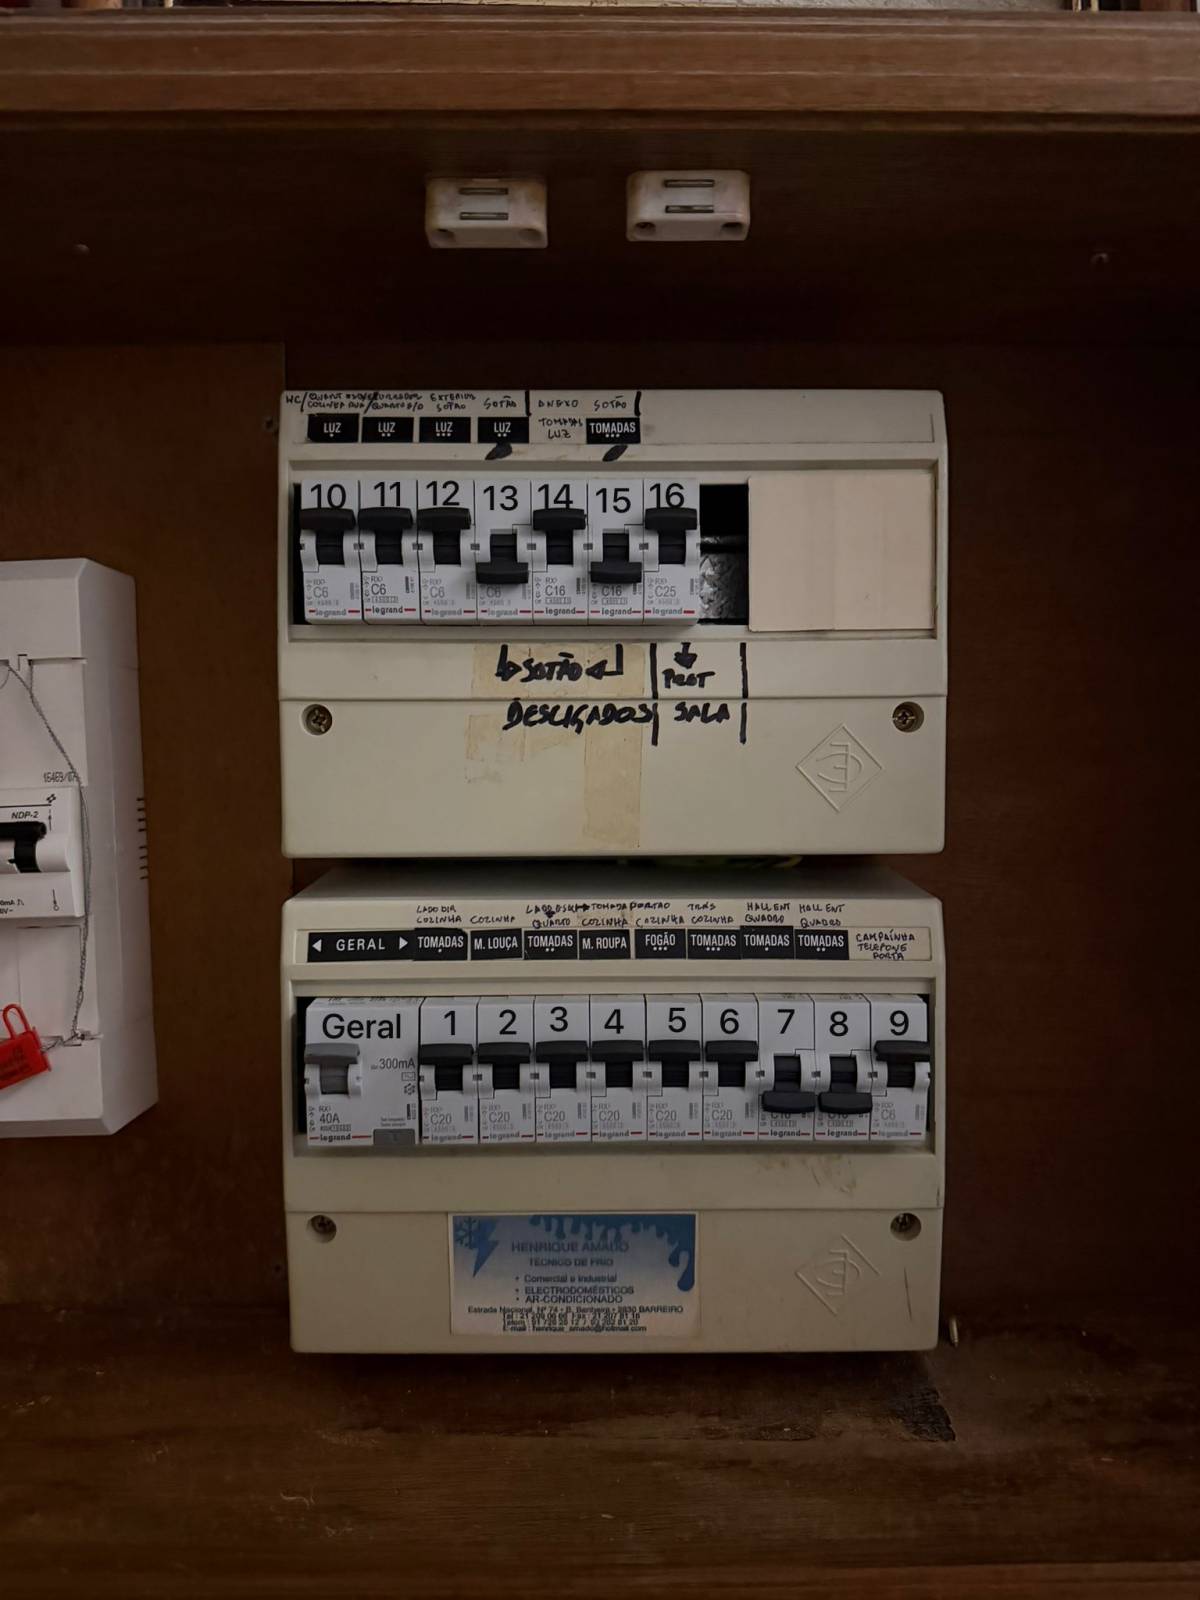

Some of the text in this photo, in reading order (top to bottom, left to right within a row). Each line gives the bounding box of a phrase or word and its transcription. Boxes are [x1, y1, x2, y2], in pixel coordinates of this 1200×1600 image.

[323, 422, 341, 433] LUZ
[378, 422, 396, 433] LUZ
[435, 422, 453, 433] LUZ
[494, 422, 511, 433] LUZ
[590, 423, 636, 434] TOMADAS
[548, 429, 571, 439] LUZ
[310, 483, 347, 508] 10
[373, 481, 401, 507] 11
[426, 480, 460, 506] 12
[483, 485, 518, 511] 13
[537, 484, 574, 508] 14
[649, 483, 685, 508] 16
[595, 487, 631, 513] 15
[313, 586, 329, 598] C6
[371, 584, 387, 595] C6
[430, 586, 445, 598] C6
[545, 585, 566, 596] C16
[602, 585, 623, 596] C16
[655, 585, 677, 598] C25
[315, 608, 347, 617] legrand
[372, 606, 403, 615] legrand
[545, 607, 576, 617] legrand
[602, 607, 633, 617] legrand
[652, 607, 683, 617] legrand
[520, 652, 583, 683] SOTÃO
[502, 697, 653, 734] DESLIGADOS
[674, 701, 730, 724] SALA
[11, 811, 39, 820] NDP-2
[416, 905, 439, 914] LADO
[747, 902, 790, 912] HALL ENT
[799, 903, 845, 913] HALL ENT
[416, 915, 462, 924] COZINHA
[470, 915, 516, 924] COZINHA
[582, 917, 628, 928] COZINHA
[691, 915, 734, 924] COZINHA
[335, 938, 386, 951] GERAL
[417, 936, 464, 948] TOMADAS
[474, 936, 518, 950] M. LOUÇA
[528, 935, 573, 947] TOMADAS
[582, 936, 627, 949] M. ROUPA
[646, 931, 676, 946] FOGÃO
[691, 934, 737, 946] TOMADAS
[744, 934, 790, 946] TOMADAS
[798, 934, 844, 947] TOMADAS
[444, 1010, 456, 1036] 1
[499, 1009, 517, 1035] 2
[550, 1006, 569, 1032] 3
[604, 1008, 624, 1034] 4
[668, 1007, 687, 1033] 5
[720, 1008, 739, 1034] 6
[777, 1009, 795, 1034] 7
[829, 1011, 849, 1037] 8
[889, 1010, 909, 1036] 9
[322, 1013, 401, 1039] Geral
[379, 1058, 415, 1070] 300mA
[319, 1112, 340, 1124] 40A
[430, 1113, 452, 1125] C20
[489, 1112, 510, 1124] C20
[544, 1110, 565, 1122] C20
[600, 1110, 620, 1121] C20
[656, 1110, 677, 1121] C20
[712, 1110, 732, 1121] C20
[320, 1133, 351, 1142] legrand
[431, 1133, 461, 1142] legrand
[545, 1131, 575, 1139] legrand
[600, 1130, 629, 1139] legrand
[656, 1130, 686, 1139] legrand
[712, 1130, 742, 1138] legrand
[770, 1129, 801, 1137] legrand
[827, 1129, 858, 1137] legrand
[512, 1241, 579, 1253] HENRIQUE
[574, 1257, 588, 1267] DE
[524, 1274, 567, 1283] Comercial
[525, 1285, 634, 1295] ELECTRODOMÉSTICOS
[525, 1295, 623, 1304] AR-CONDICIONADO
